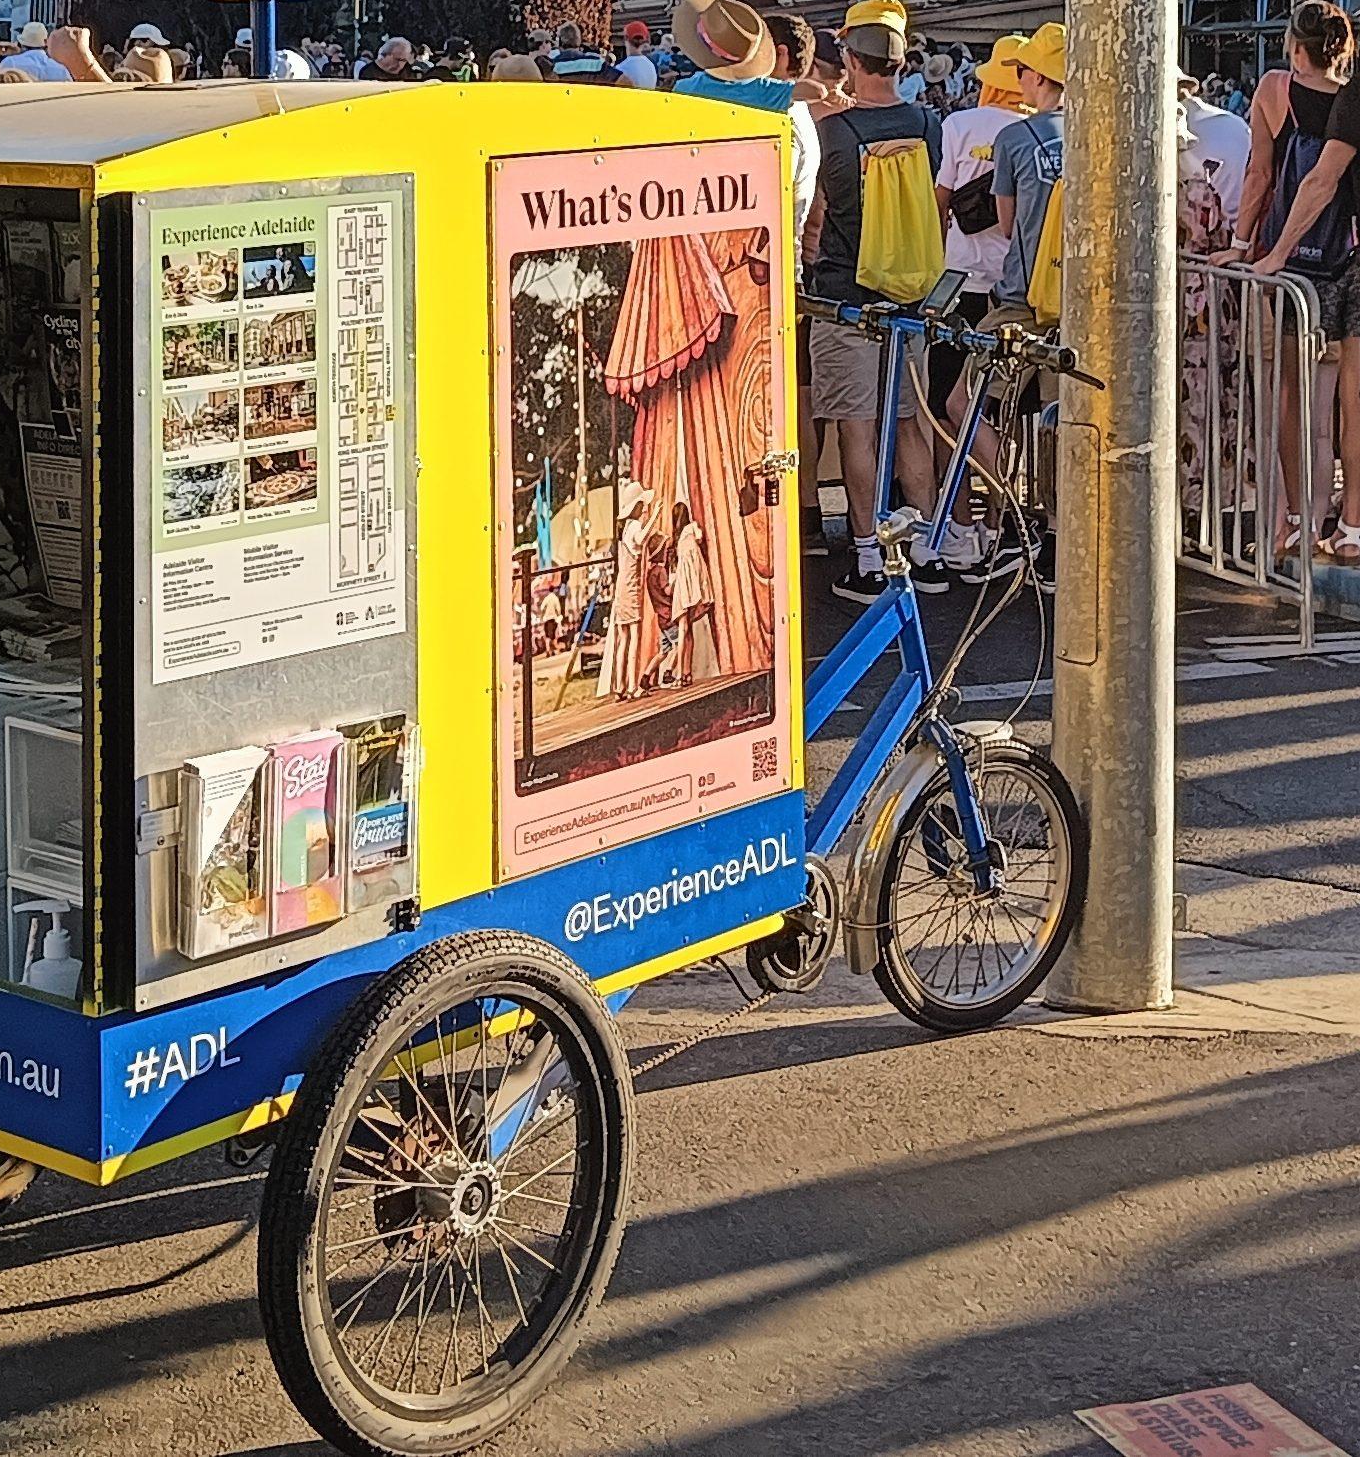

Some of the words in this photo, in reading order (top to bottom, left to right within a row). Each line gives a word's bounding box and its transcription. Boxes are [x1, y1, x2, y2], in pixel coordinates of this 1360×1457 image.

[522, 185, 633, 231] What's
[640, 180, 685, 221] On
[693, 173, 758, 216] ADL
[162, 224, 247, 247] Experience
[250, 216, 315, 238] Adelaide
[43, 314, 78, 332] Cycling
[284, 752, 331, 800] Stay
[523, 786, 683, 845] ExperienceAdelaide.com.au/WhatsOn
[564, 832, 797, 942] @ExperienceADL
[124, 1026, 241, 1099] #ADL
[1149, 1402, 1208, 1439] CHASE
